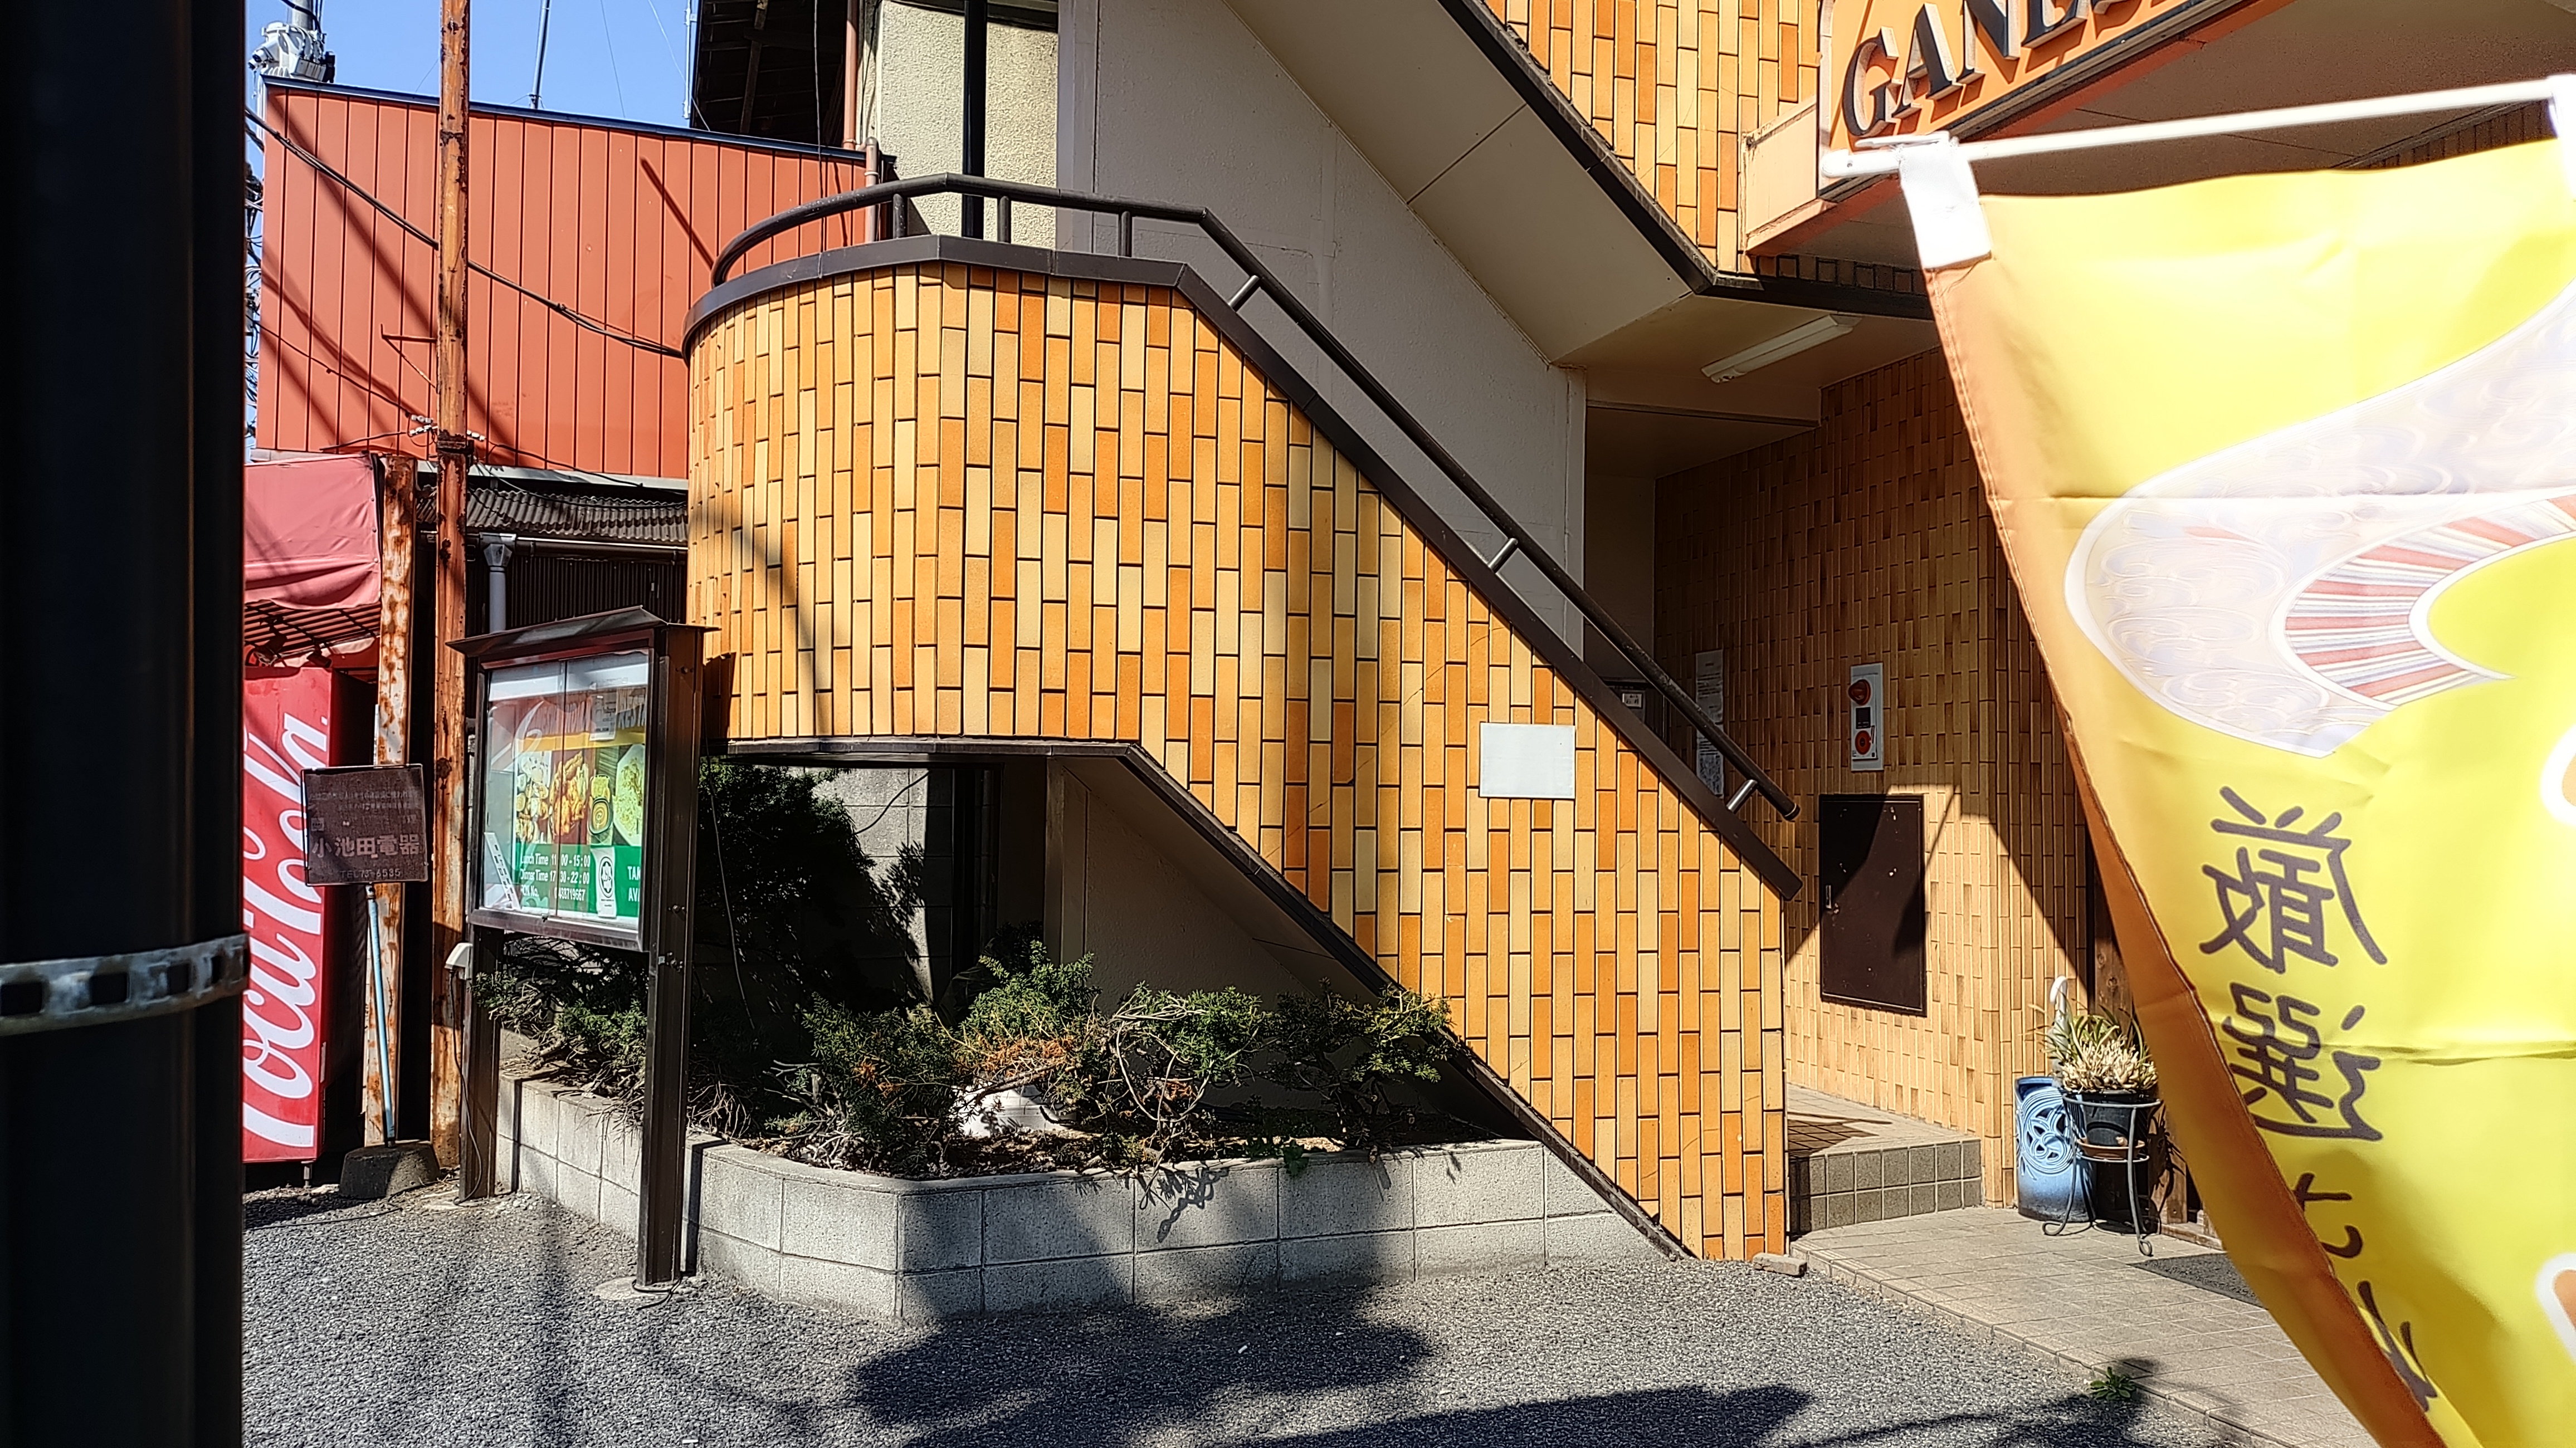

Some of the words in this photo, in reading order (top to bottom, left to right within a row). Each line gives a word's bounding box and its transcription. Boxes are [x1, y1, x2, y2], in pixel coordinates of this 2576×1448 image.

[311, 834, 420, 858] 小池田電器
[535, 853, 549, 865] Time
[535, 869, 549, 882] Time
